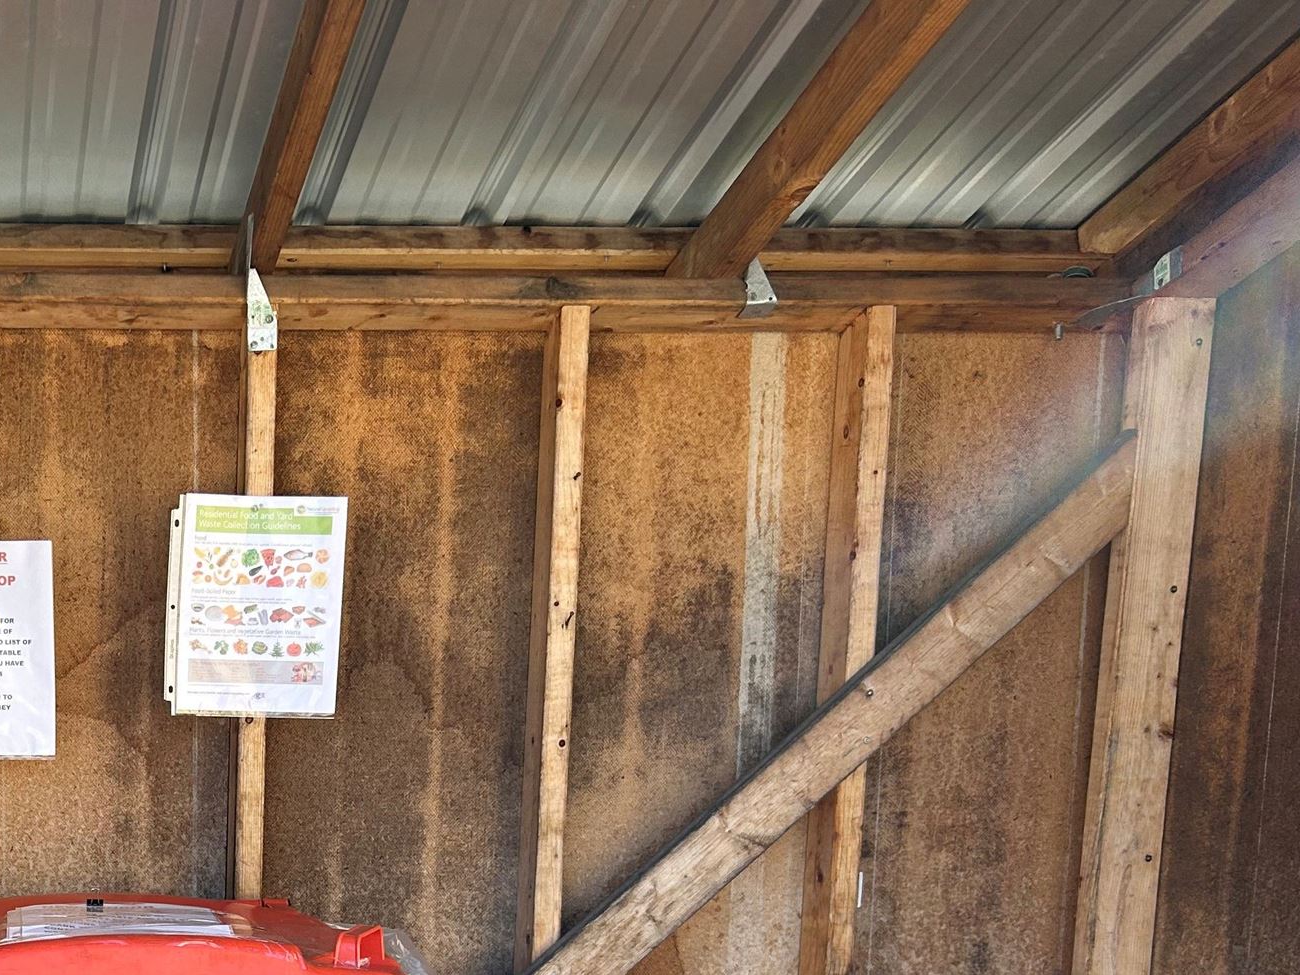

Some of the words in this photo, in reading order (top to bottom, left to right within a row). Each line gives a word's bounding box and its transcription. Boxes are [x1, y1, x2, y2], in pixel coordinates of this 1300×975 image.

[199, 510, 238, 519] Residential
[241, 511, 258, 520] Food
[260, 512, 274, 520] and
[262, 521, 301, 530] Guidelines
